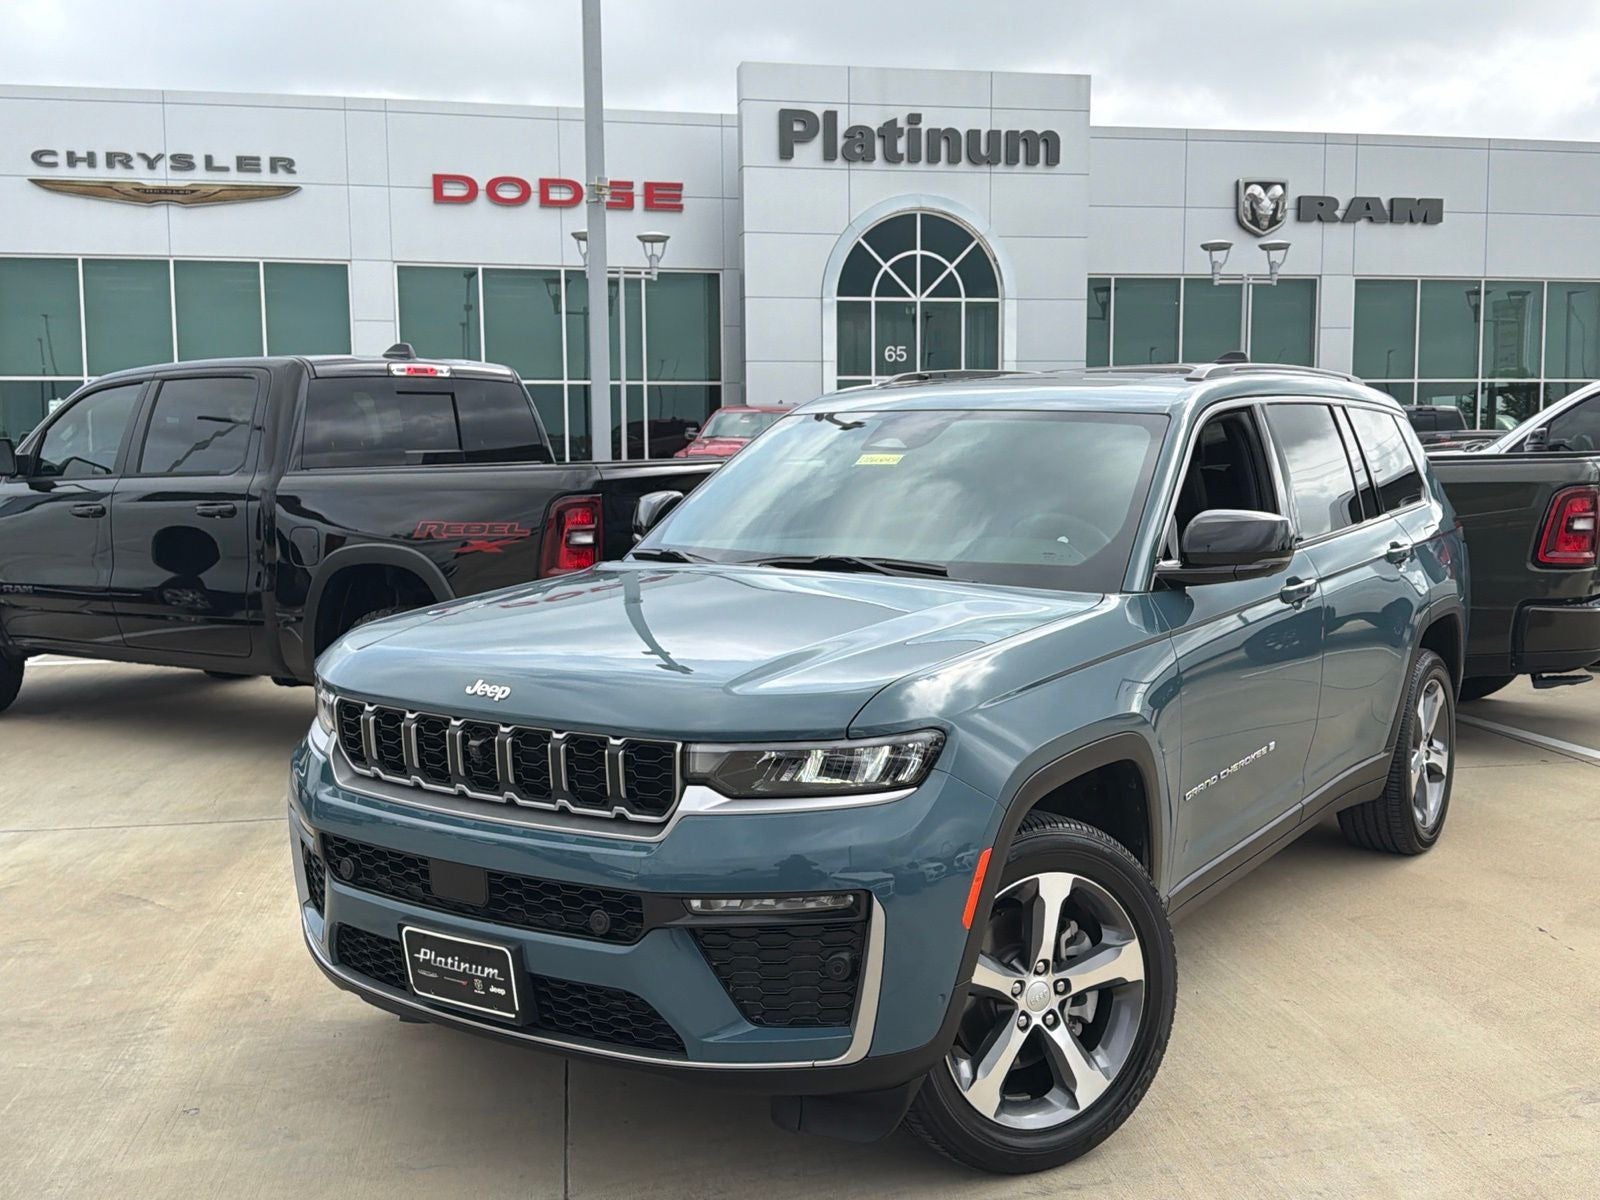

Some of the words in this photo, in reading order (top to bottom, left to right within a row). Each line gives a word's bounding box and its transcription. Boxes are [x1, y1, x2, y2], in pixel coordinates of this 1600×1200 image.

[777, 108, 1061, 167] Platinum
[31, 149, 297, 174] CHRYSLER
[432, 173, 684, 212] DODGE
[1297, 195, 1444, 225] RAM
[884, 345, 907, 362] 65
[412, 520, 531, 539] REBEL
[2, 584, 33, 593] RAM
[465, 679, 511, 702] Jeep
[1184, 774, 1218, 801] GRAND
[413, 947, 505, 981] Platinum
